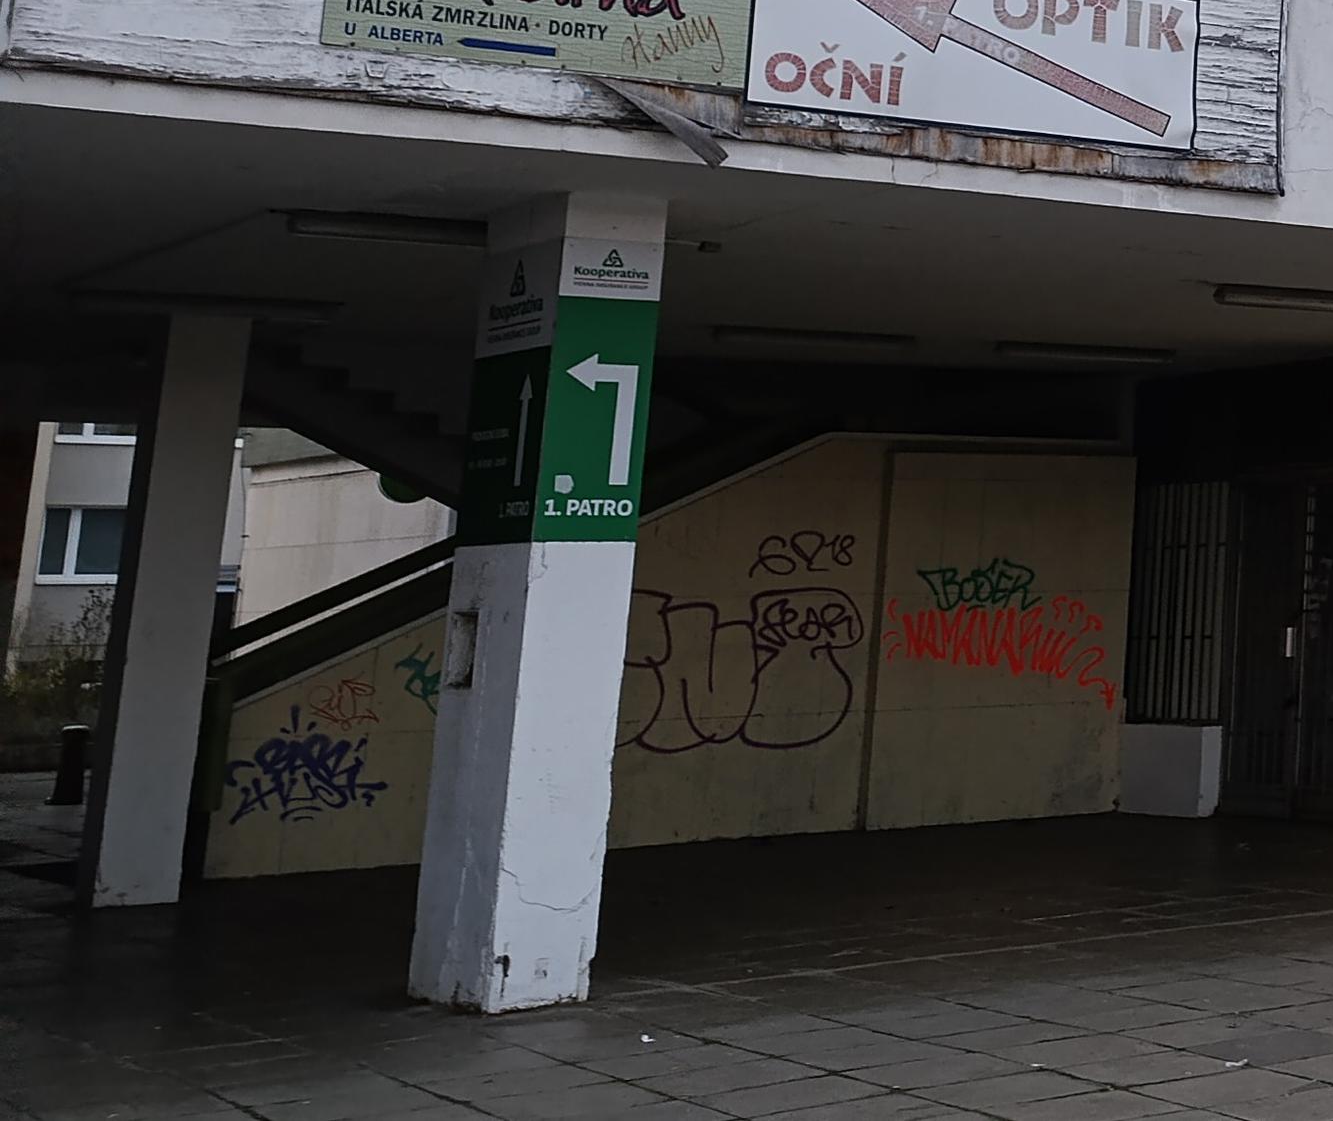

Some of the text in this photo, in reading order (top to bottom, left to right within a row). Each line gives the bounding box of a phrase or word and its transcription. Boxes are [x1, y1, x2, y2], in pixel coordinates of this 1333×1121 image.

[344, 22, 444, 46] U ALBERTA
[431, 6, 530, 33] ZMRZLINA
[548, 22, 608, 41] DORTY
[763, 41, 906, 107] OČNÍ
[573, 265, 649, 281] Kooperativa
[543, 498, 634, 517] 1. PATRO
